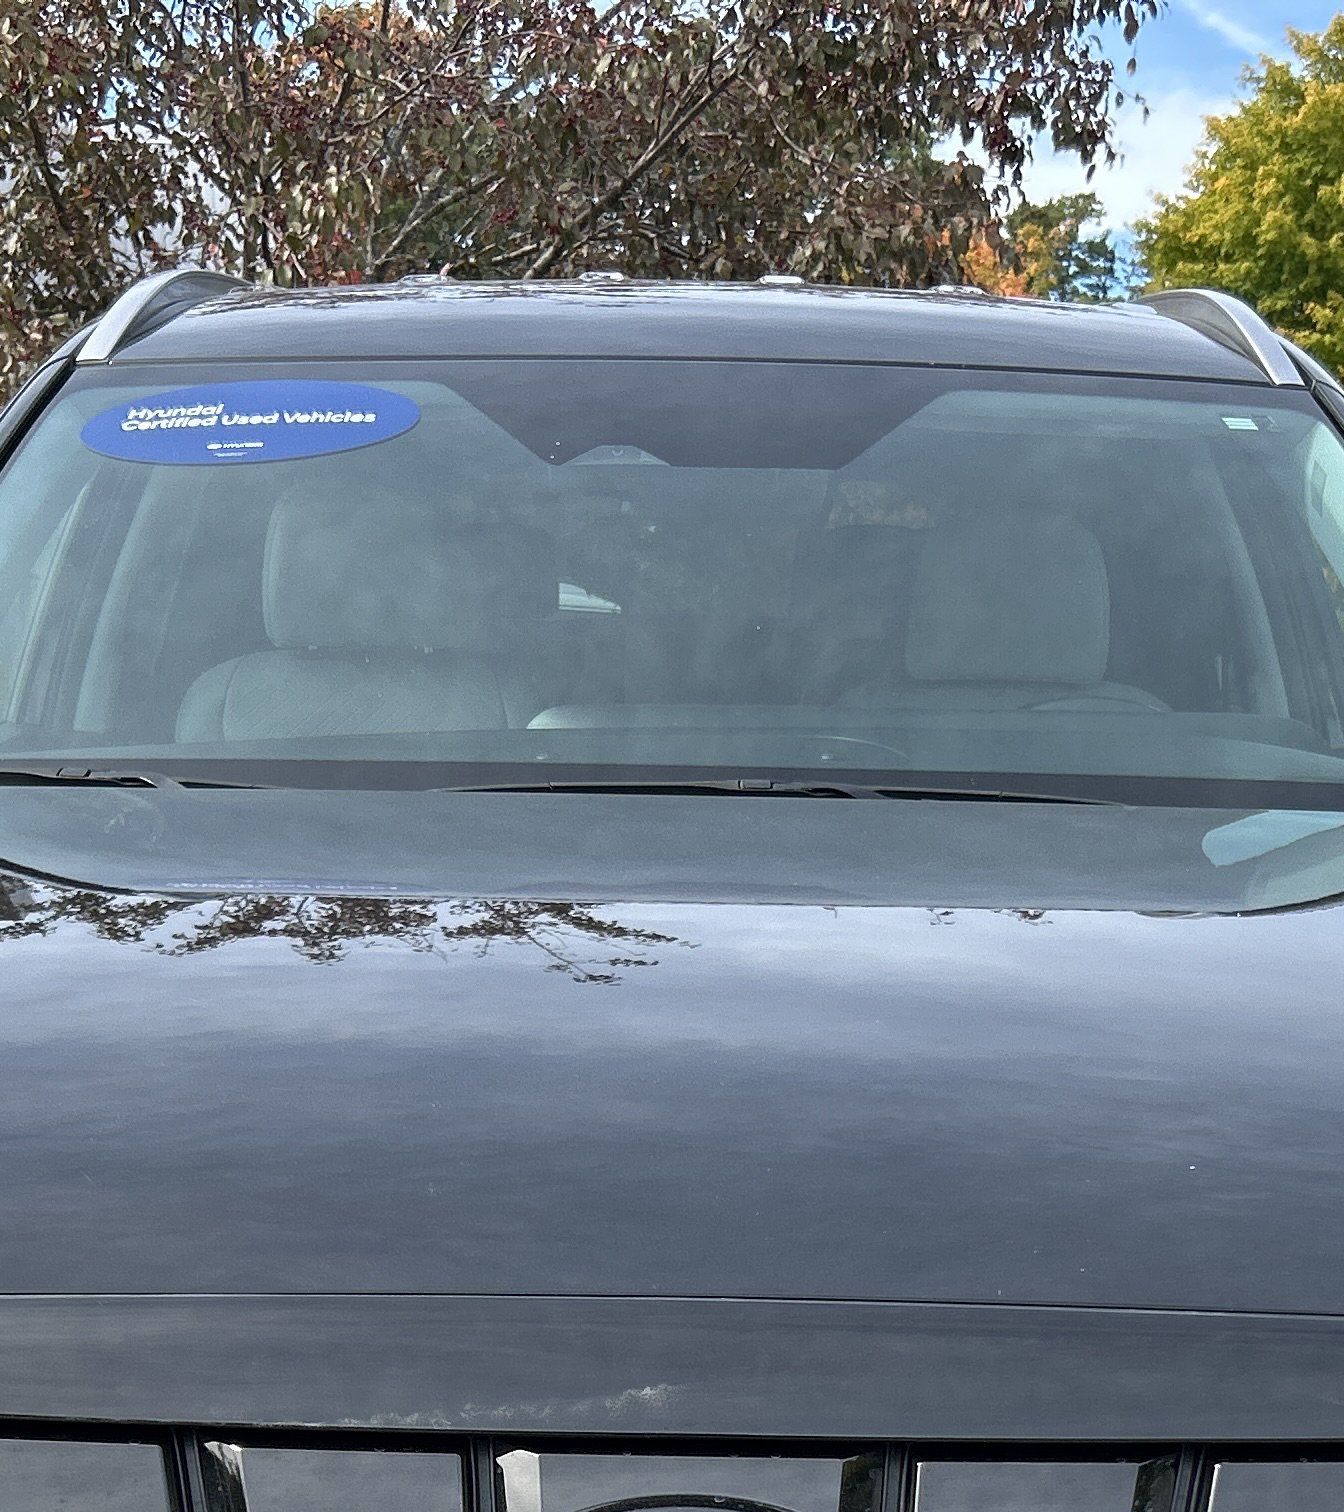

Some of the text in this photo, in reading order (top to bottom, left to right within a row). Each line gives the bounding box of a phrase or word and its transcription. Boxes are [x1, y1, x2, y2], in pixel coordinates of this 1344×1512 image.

[121, 409, 377, 431] Certified Used Vehicles
[127, 403, 225, 421] Hyundai
